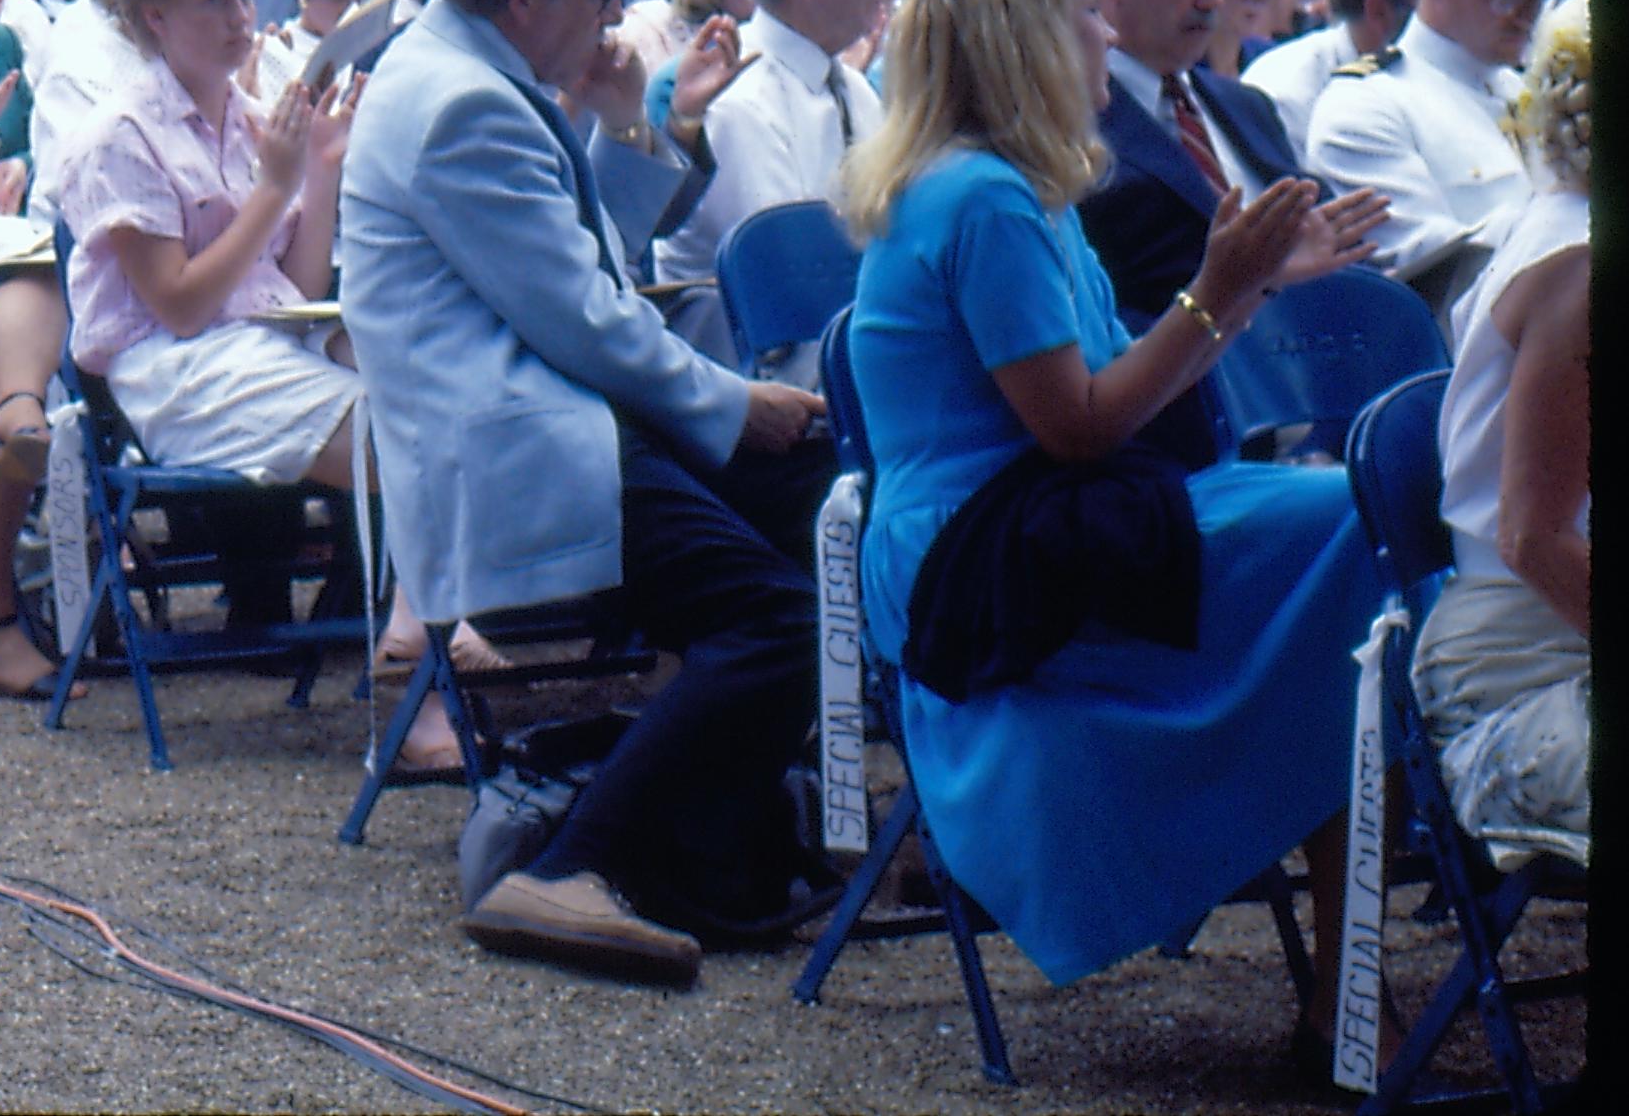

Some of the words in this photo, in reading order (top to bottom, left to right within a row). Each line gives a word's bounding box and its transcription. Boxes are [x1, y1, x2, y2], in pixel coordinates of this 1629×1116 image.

[49, 456, 81, 608] SPONSORS
[823, 519, 856, 667] GUESTS
[825, 699, 863, 841] SPECIAL
[1340, 921, 1382, 1084] SPECIAL
